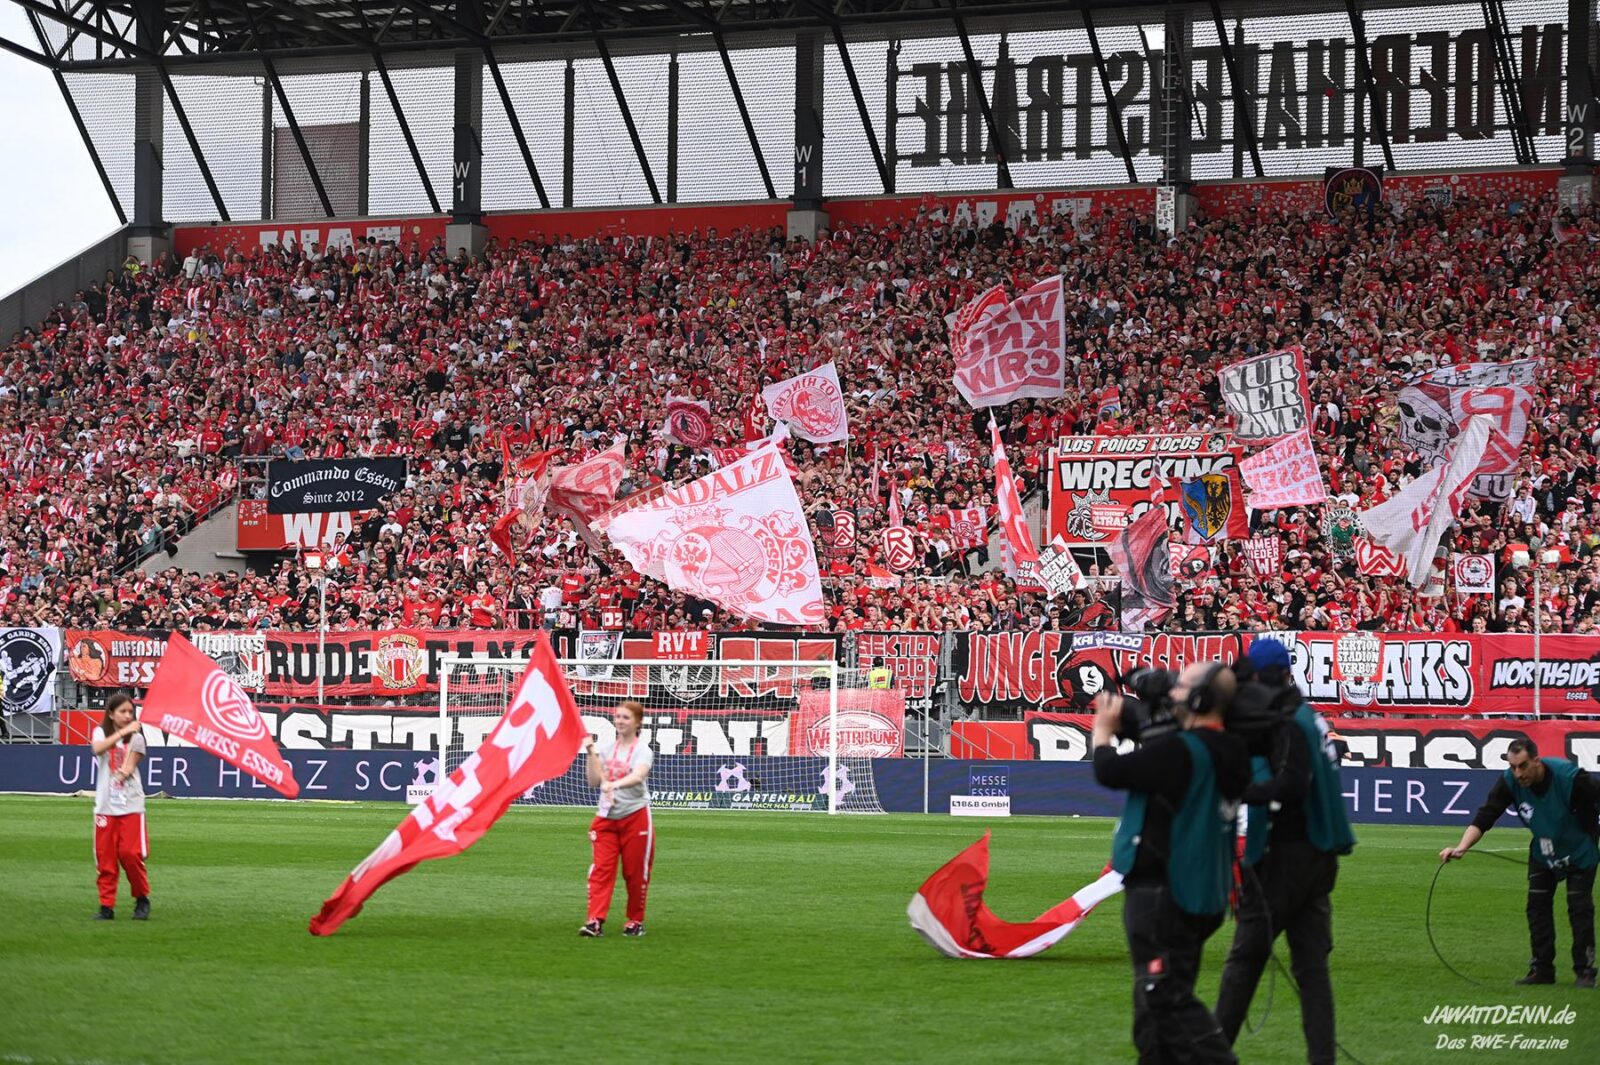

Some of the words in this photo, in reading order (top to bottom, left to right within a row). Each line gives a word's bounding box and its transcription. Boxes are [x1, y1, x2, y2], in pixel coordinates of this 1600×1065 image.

[1566, 104, 1586, 124] W
[1569, 127, 1583, 150] 2
[795, 145, 811, 162] W
[452, 161, 469, 178] W
[1063, 438, 1095, 453] LOS
[271, 466, 350, 498] Commando
[354, 466, 398, 492] Essen
[1060, 456, 1235, 490] WRECKING
[303, 492, 333, 504] Since
[336, 490, 364, 502] 2012
[657, 632, 702, 652] RVT
[857, 635, 942, 656] SEKTION
[1073, 634, 1093, 646] KAI
[1104, 635, 1142, 648] 2000
[267, 641, 371, 684] RUDE
[1338, 651, 1379, 662] STADION
[858, 657, 937, 677] SADION
[958, 631, 1062, 704] JUNGE
[1285, 640, 1473, 707] REAKS
[1340, 662, 1377, 674] VERBOT
[1493, 660, 1600, 686] NORTHSIDE
[58, 754, 191, 788] UNER
[241, 749, 283, 785] ESSEN
[972, 776, 1006, 786] MESSE
[733, 793, 816, 804] GARTENBAU
[972, 789, 1007, 797] ESSEN
